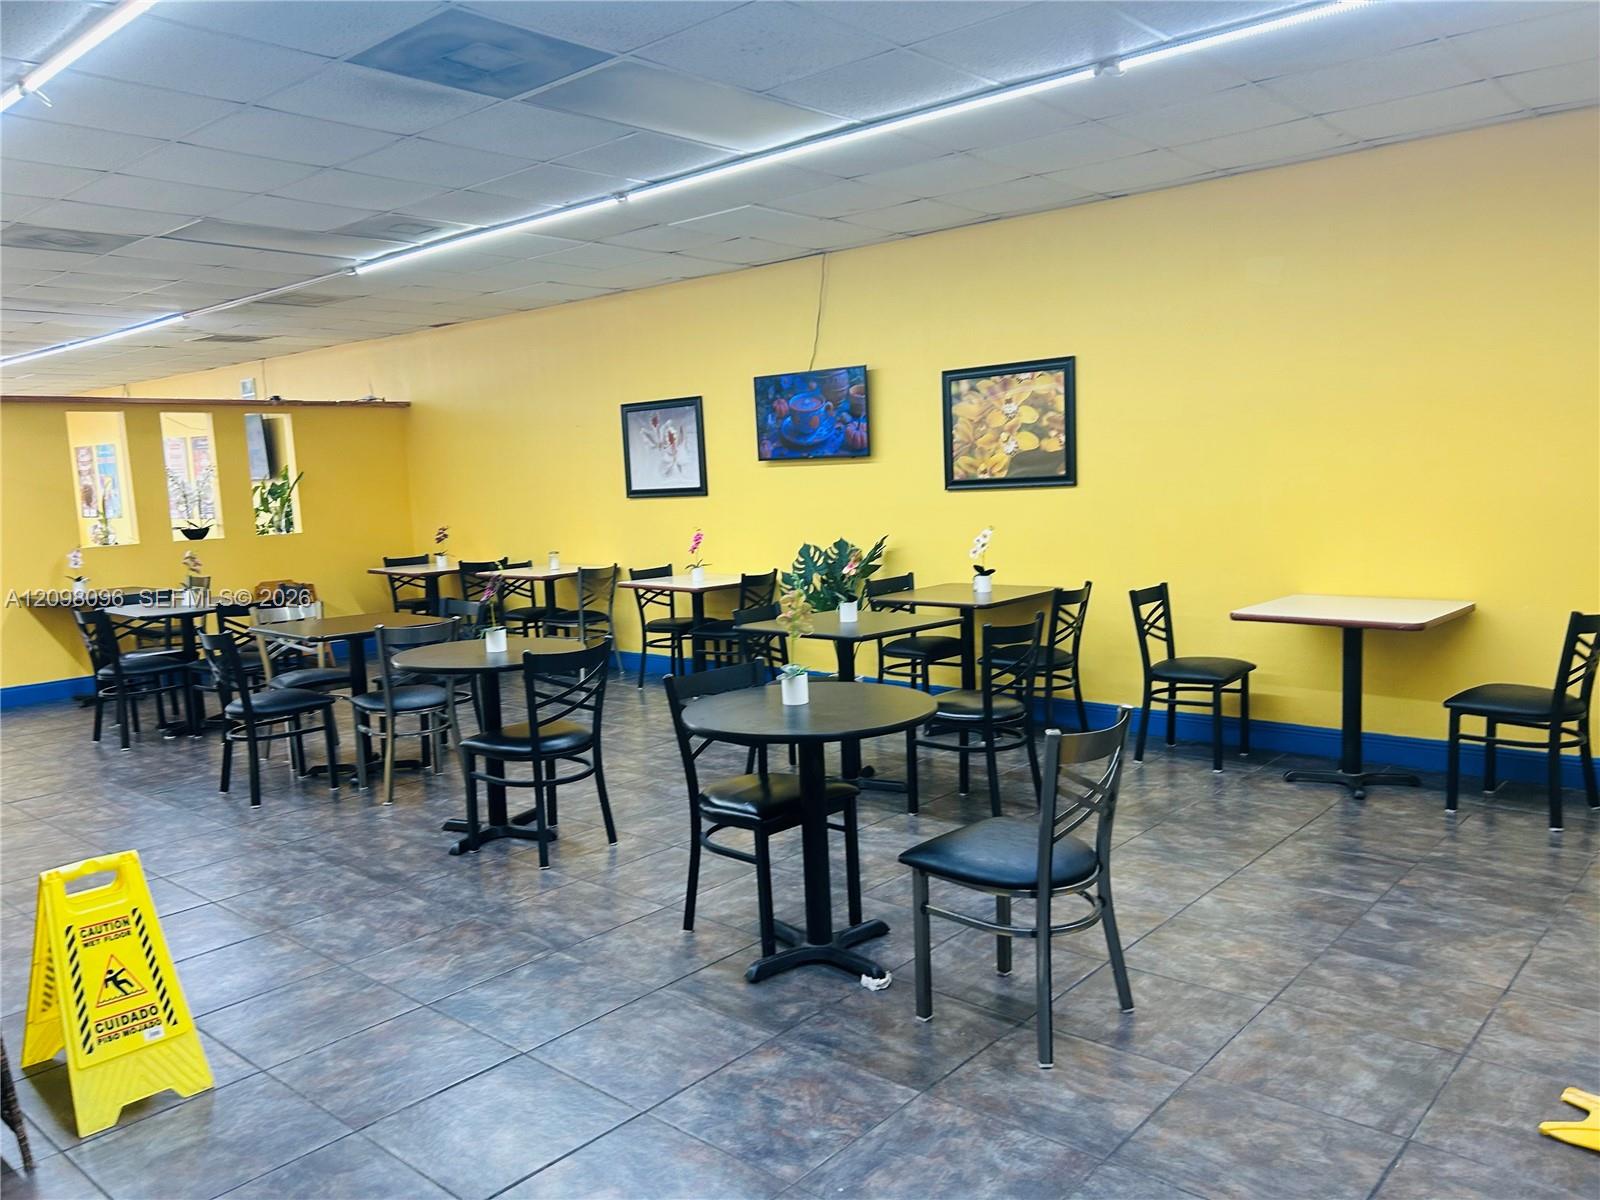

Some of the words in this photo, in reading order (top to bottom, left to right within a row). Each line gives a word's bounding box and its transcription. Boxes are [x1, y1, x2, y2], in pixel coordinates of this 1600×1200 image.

[80, 918, 130, 939] CAUTION
[104, 930, 131, 942] FLOOR
[95, 1005, 158, 1034] CUIDADO
[97, 1033, 120, 1046] PISO
[122, 1019, 161, 1037] MOJADO
